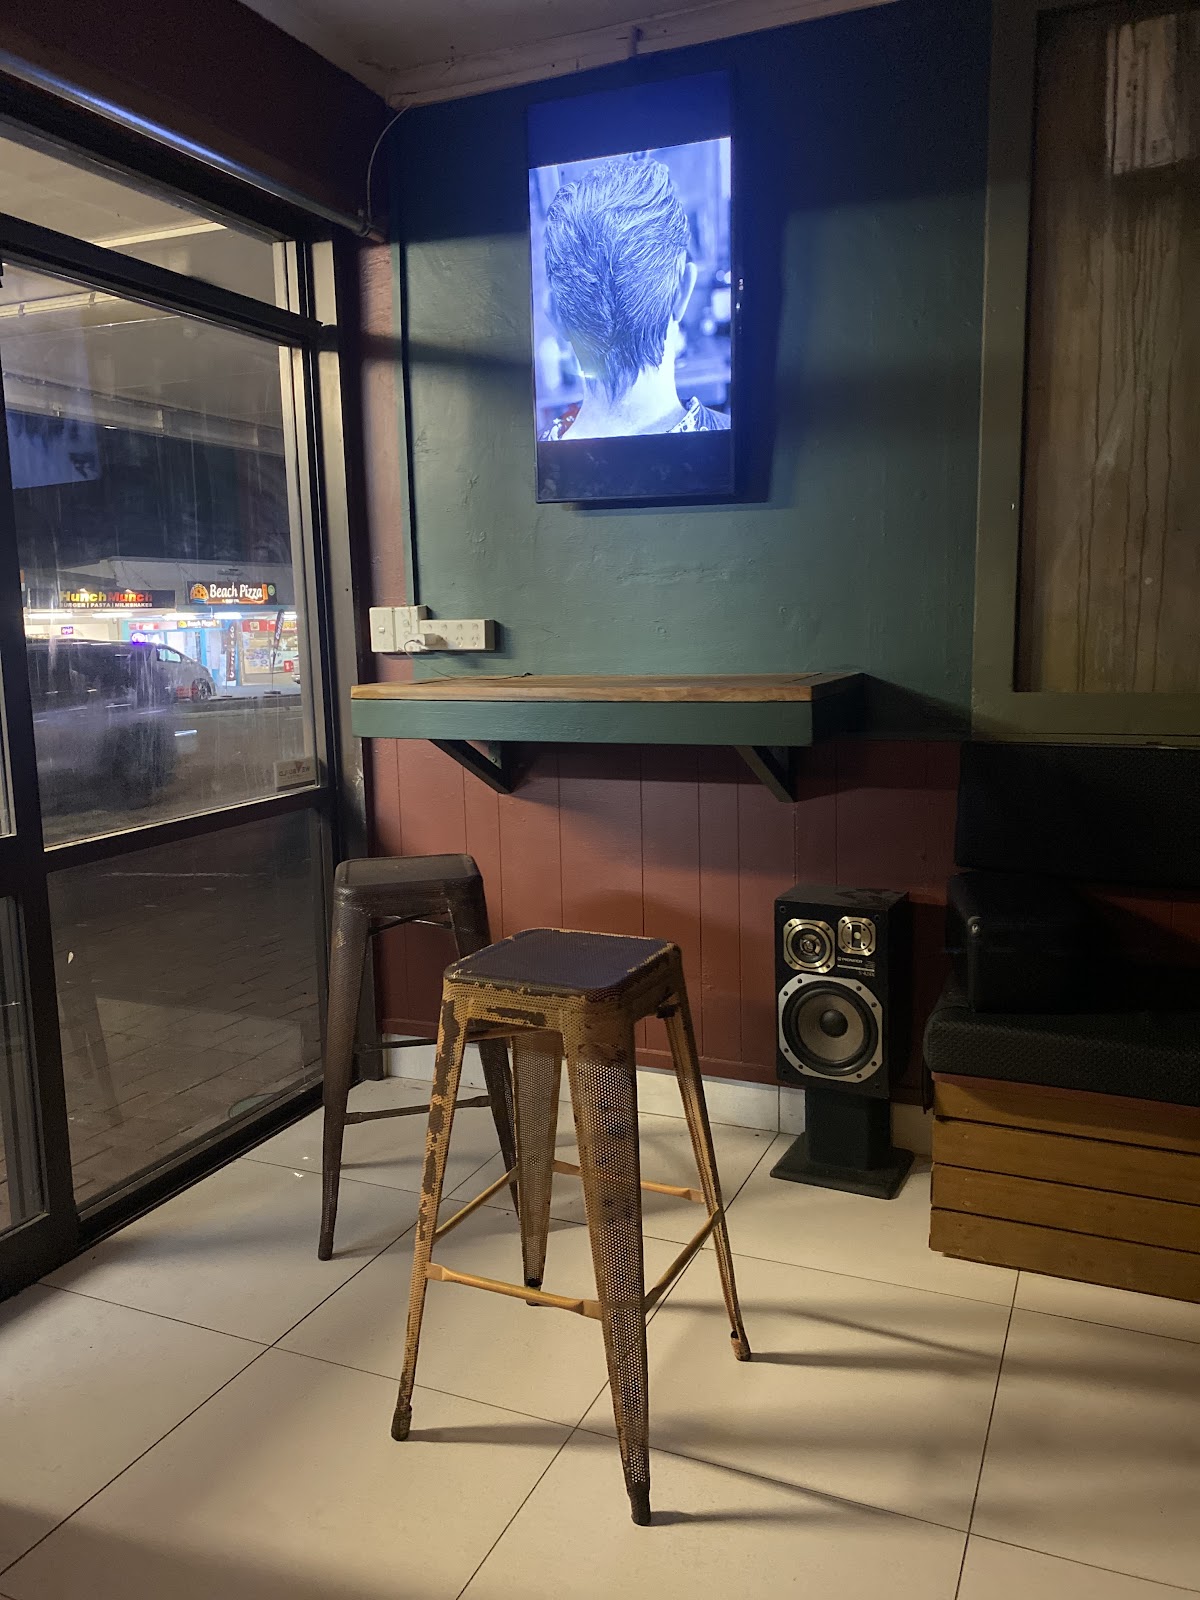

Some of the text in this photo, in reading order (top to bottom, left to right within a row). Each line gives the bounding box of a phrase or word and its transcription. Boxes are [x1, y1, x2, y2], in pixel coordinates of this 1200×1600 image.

[60, 591, 153, 603] Hunch Munch
[209, 582, 263, 600] Beach Pizza
